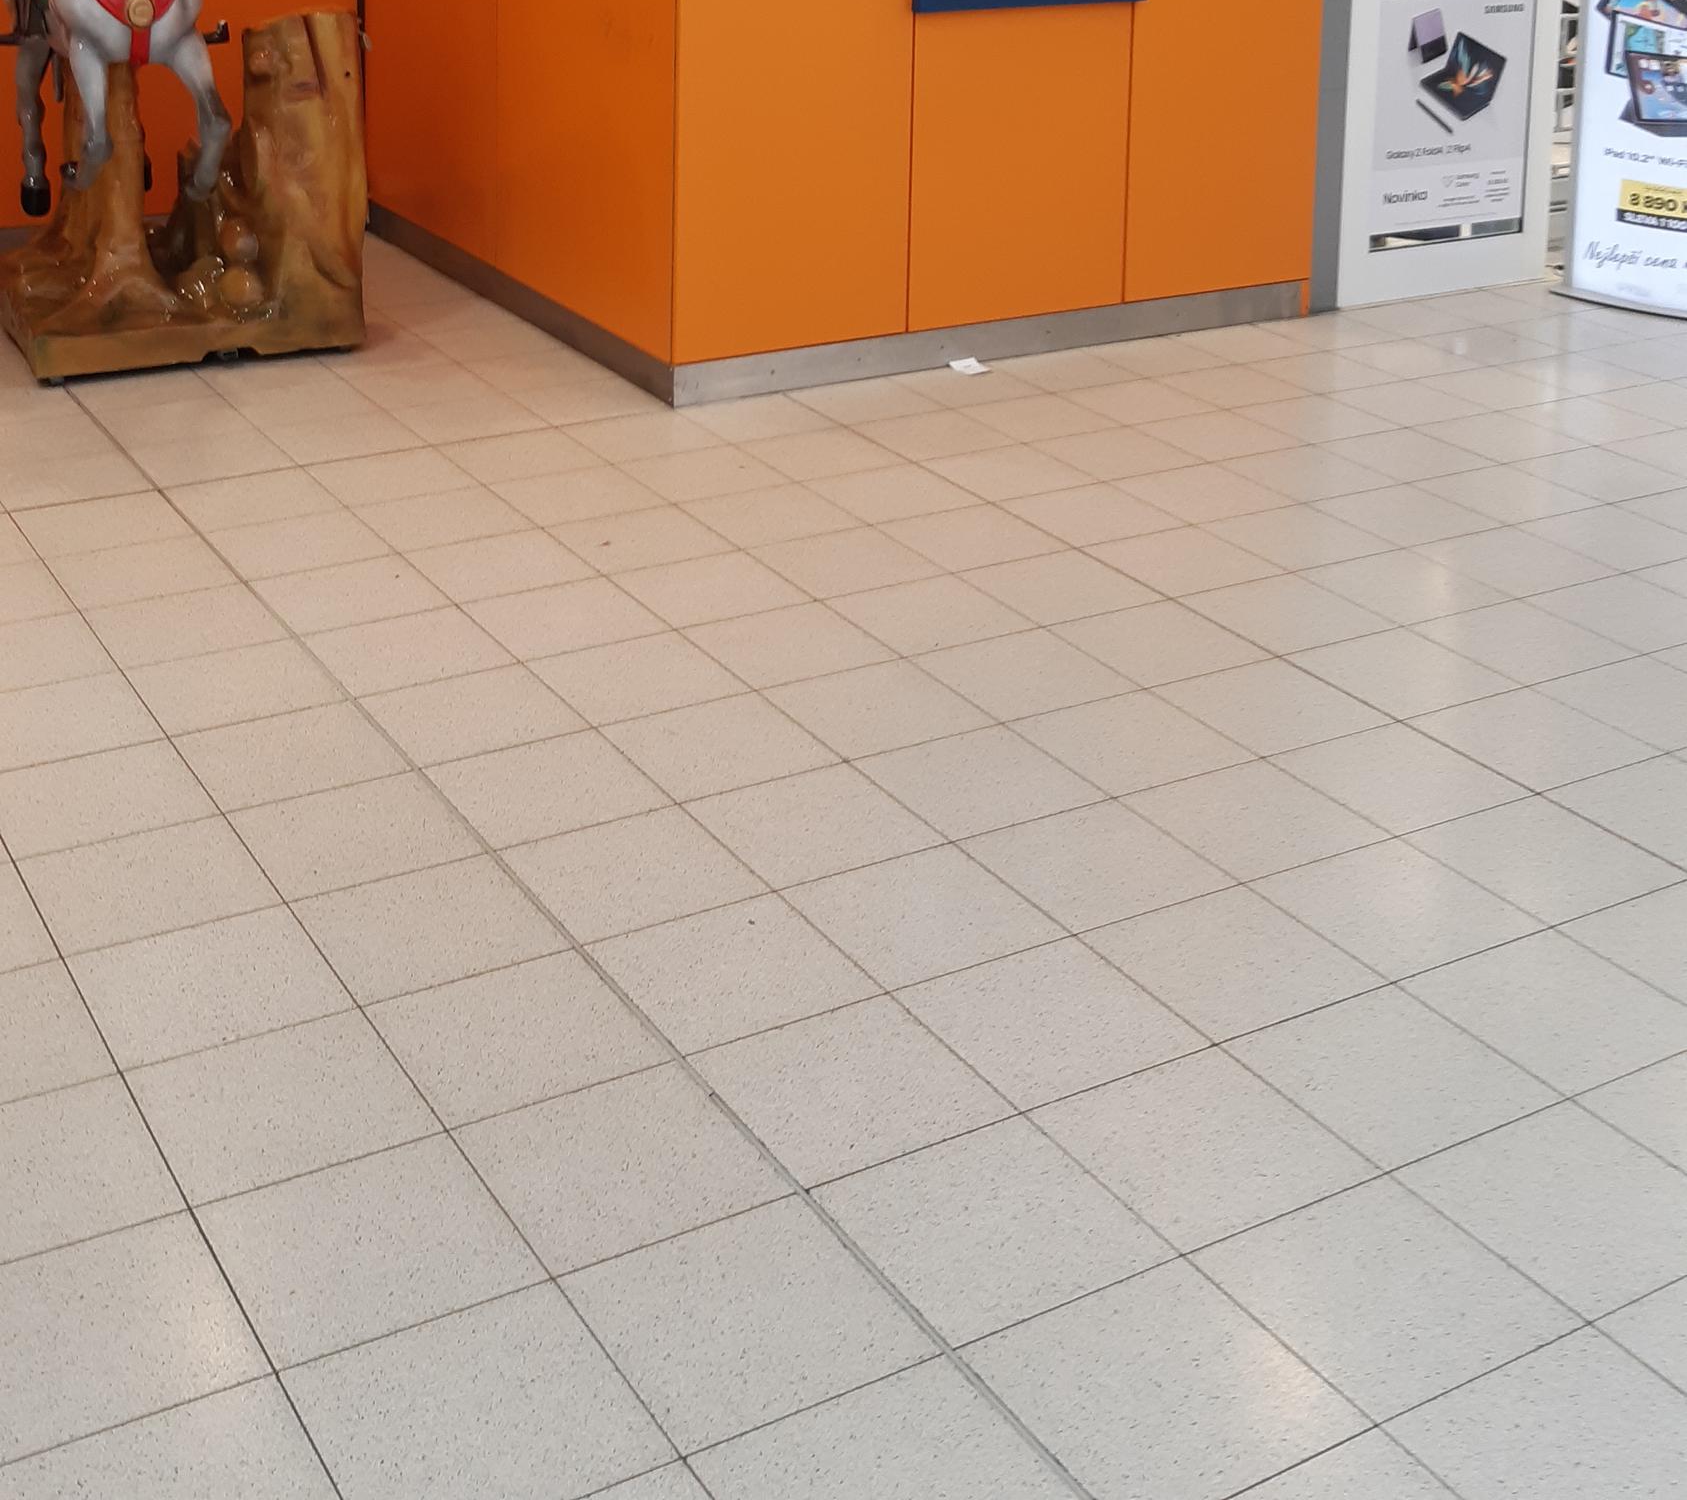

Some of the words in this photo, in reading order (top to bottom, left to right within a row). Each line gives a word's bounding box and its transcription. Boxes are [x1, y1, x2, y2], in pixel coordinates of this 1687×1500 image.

[1484, 4, 1524, 13] SAMSUNG
[1383, 189, 1428, 204] Novinka
[1643, 256, 1678, 269] cena
